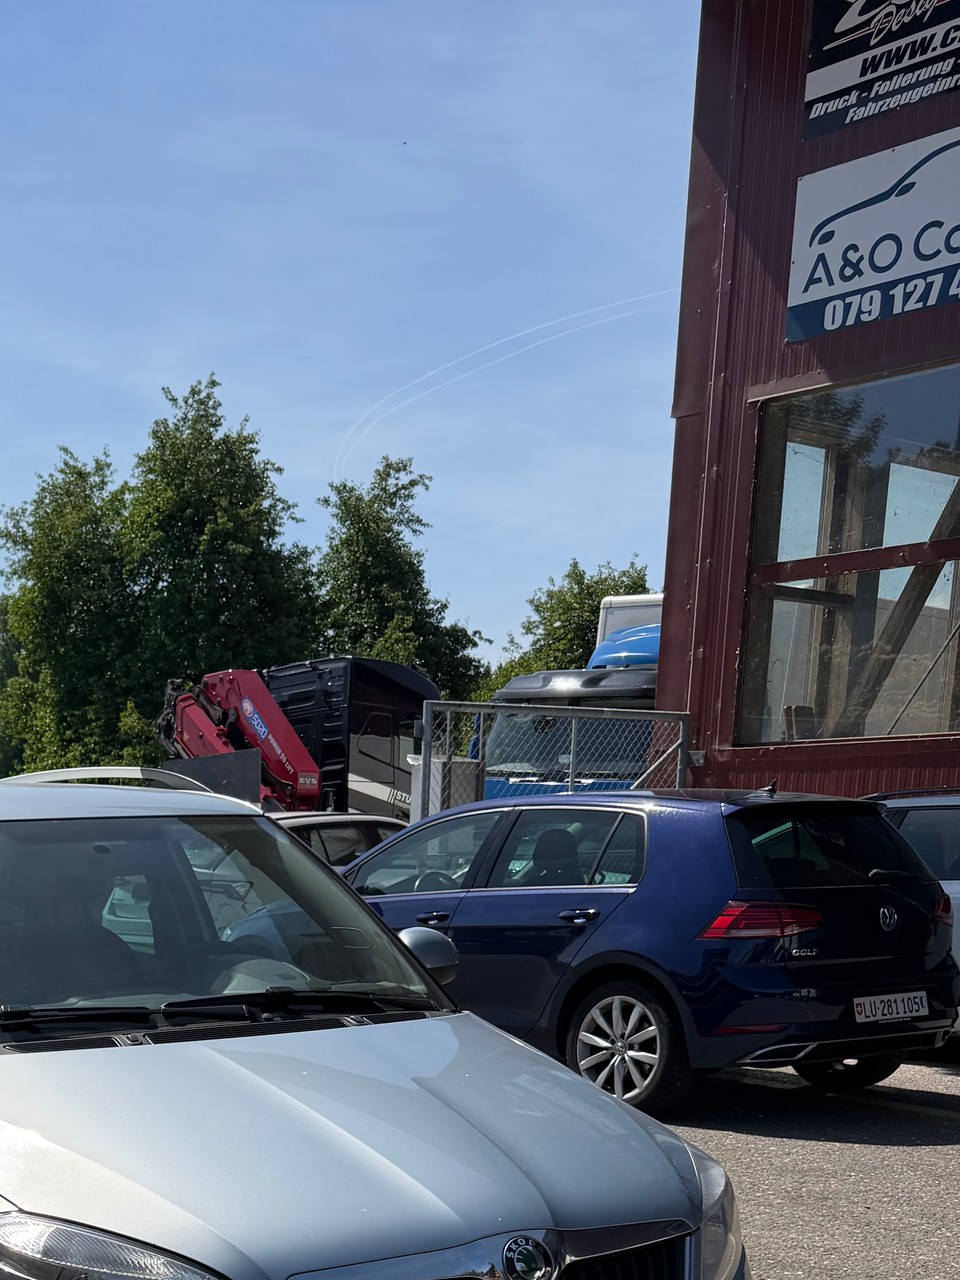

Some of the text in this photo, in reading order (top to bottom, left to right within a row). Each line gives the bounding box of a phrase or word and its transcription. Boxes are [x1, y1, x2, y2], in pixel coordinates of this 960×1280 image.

[809, 90, 860, 119] Druck
[869, 57, 956, 98] Folierung
[844, 73, 960, 124] Fahrzeugeinr
[802, 233, 903, 294] A&O
[823, 290, 882, 331] 079
[889, 273, 944, 315] 127
[299, 777, 318, 785] EVS
